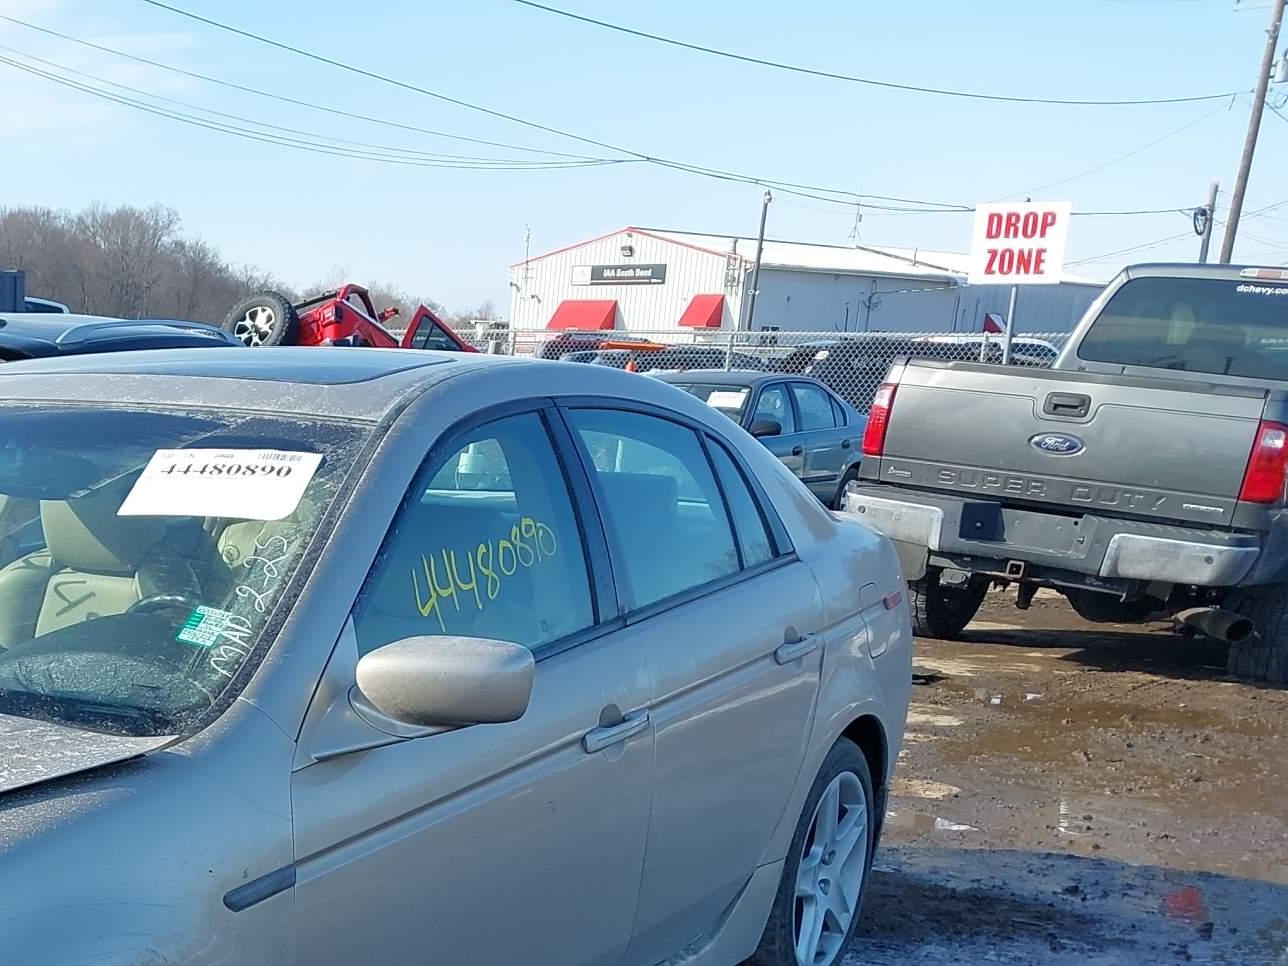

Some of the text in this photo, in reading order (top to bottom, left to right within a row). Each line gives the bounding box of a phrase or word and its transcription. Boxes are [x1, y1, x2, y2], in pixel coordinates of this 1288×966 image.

[985, 211, 1057, 239] DROP
[984, 247, 1048, 275] ZONE
[160, 463, 293, 478] 44480890
[937, 468, 1049, 497] SUPER
[1071, 484, 1168, 511] DUTY
[412, 517, 557, 633] 44480890
